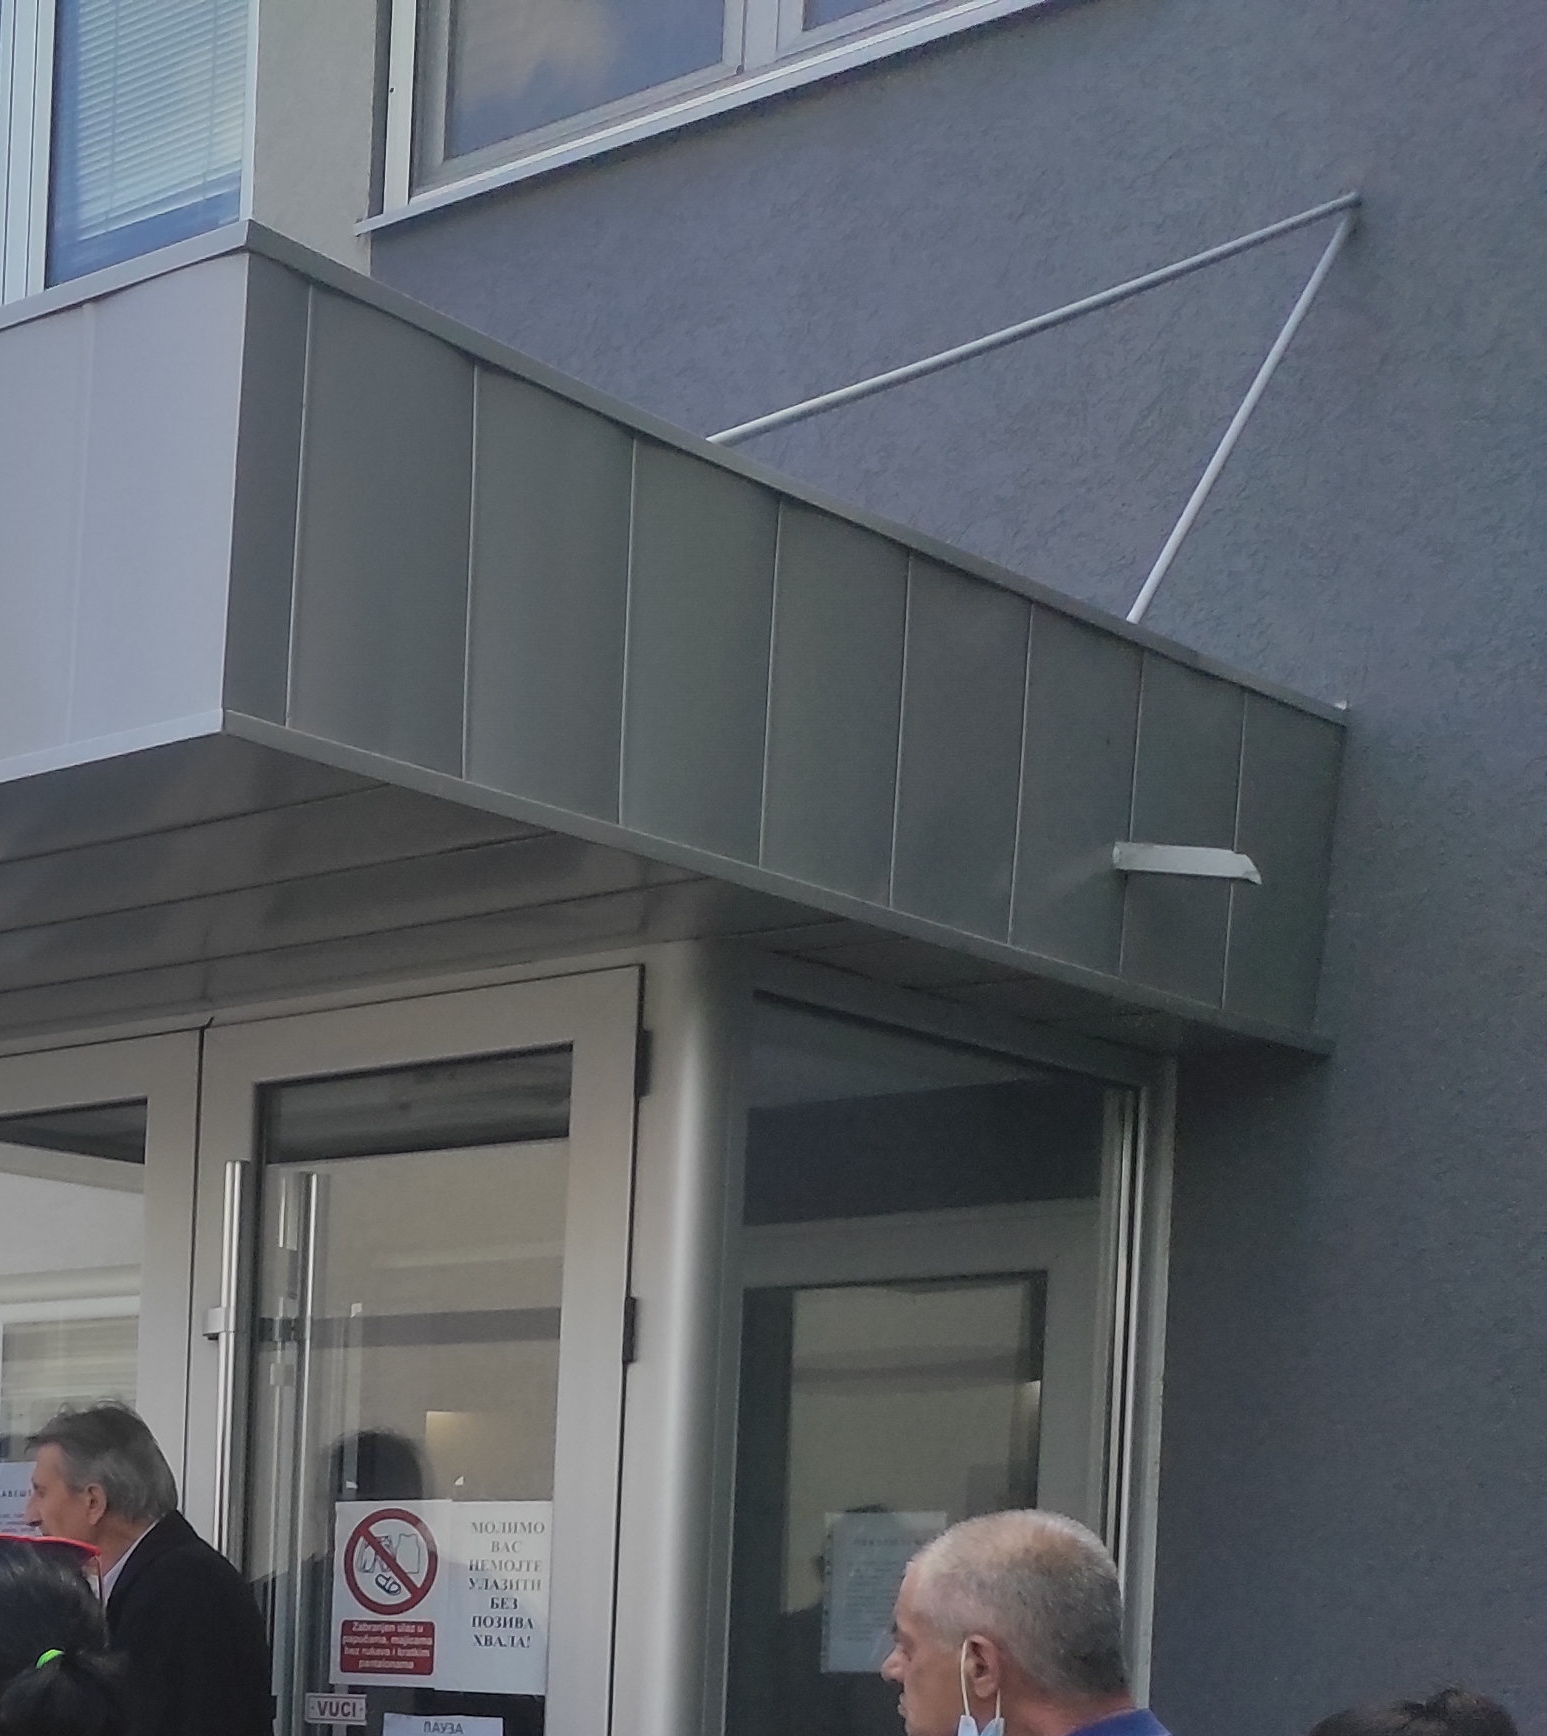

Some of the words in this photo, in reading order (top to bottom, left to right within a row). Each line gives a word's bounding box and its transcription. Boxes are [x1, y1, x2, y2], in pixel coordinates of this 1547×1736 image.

[471, 1521, 545, 1534] МОЛИМО
[491, 1540, 522, 1553] ВАС
[468, 1578, 541, 1591] УЛАЗИТИ
[490, 1597, 518, 1609] БЕЗ
[471, 1615, 534, 1629] ПОЗИВА
[473, 1634, 531, 1648] ХВАЛА!
[317, 1700, 356, 1717] VUCI
[423, 1720, 464, 1735] ПАУЗА
